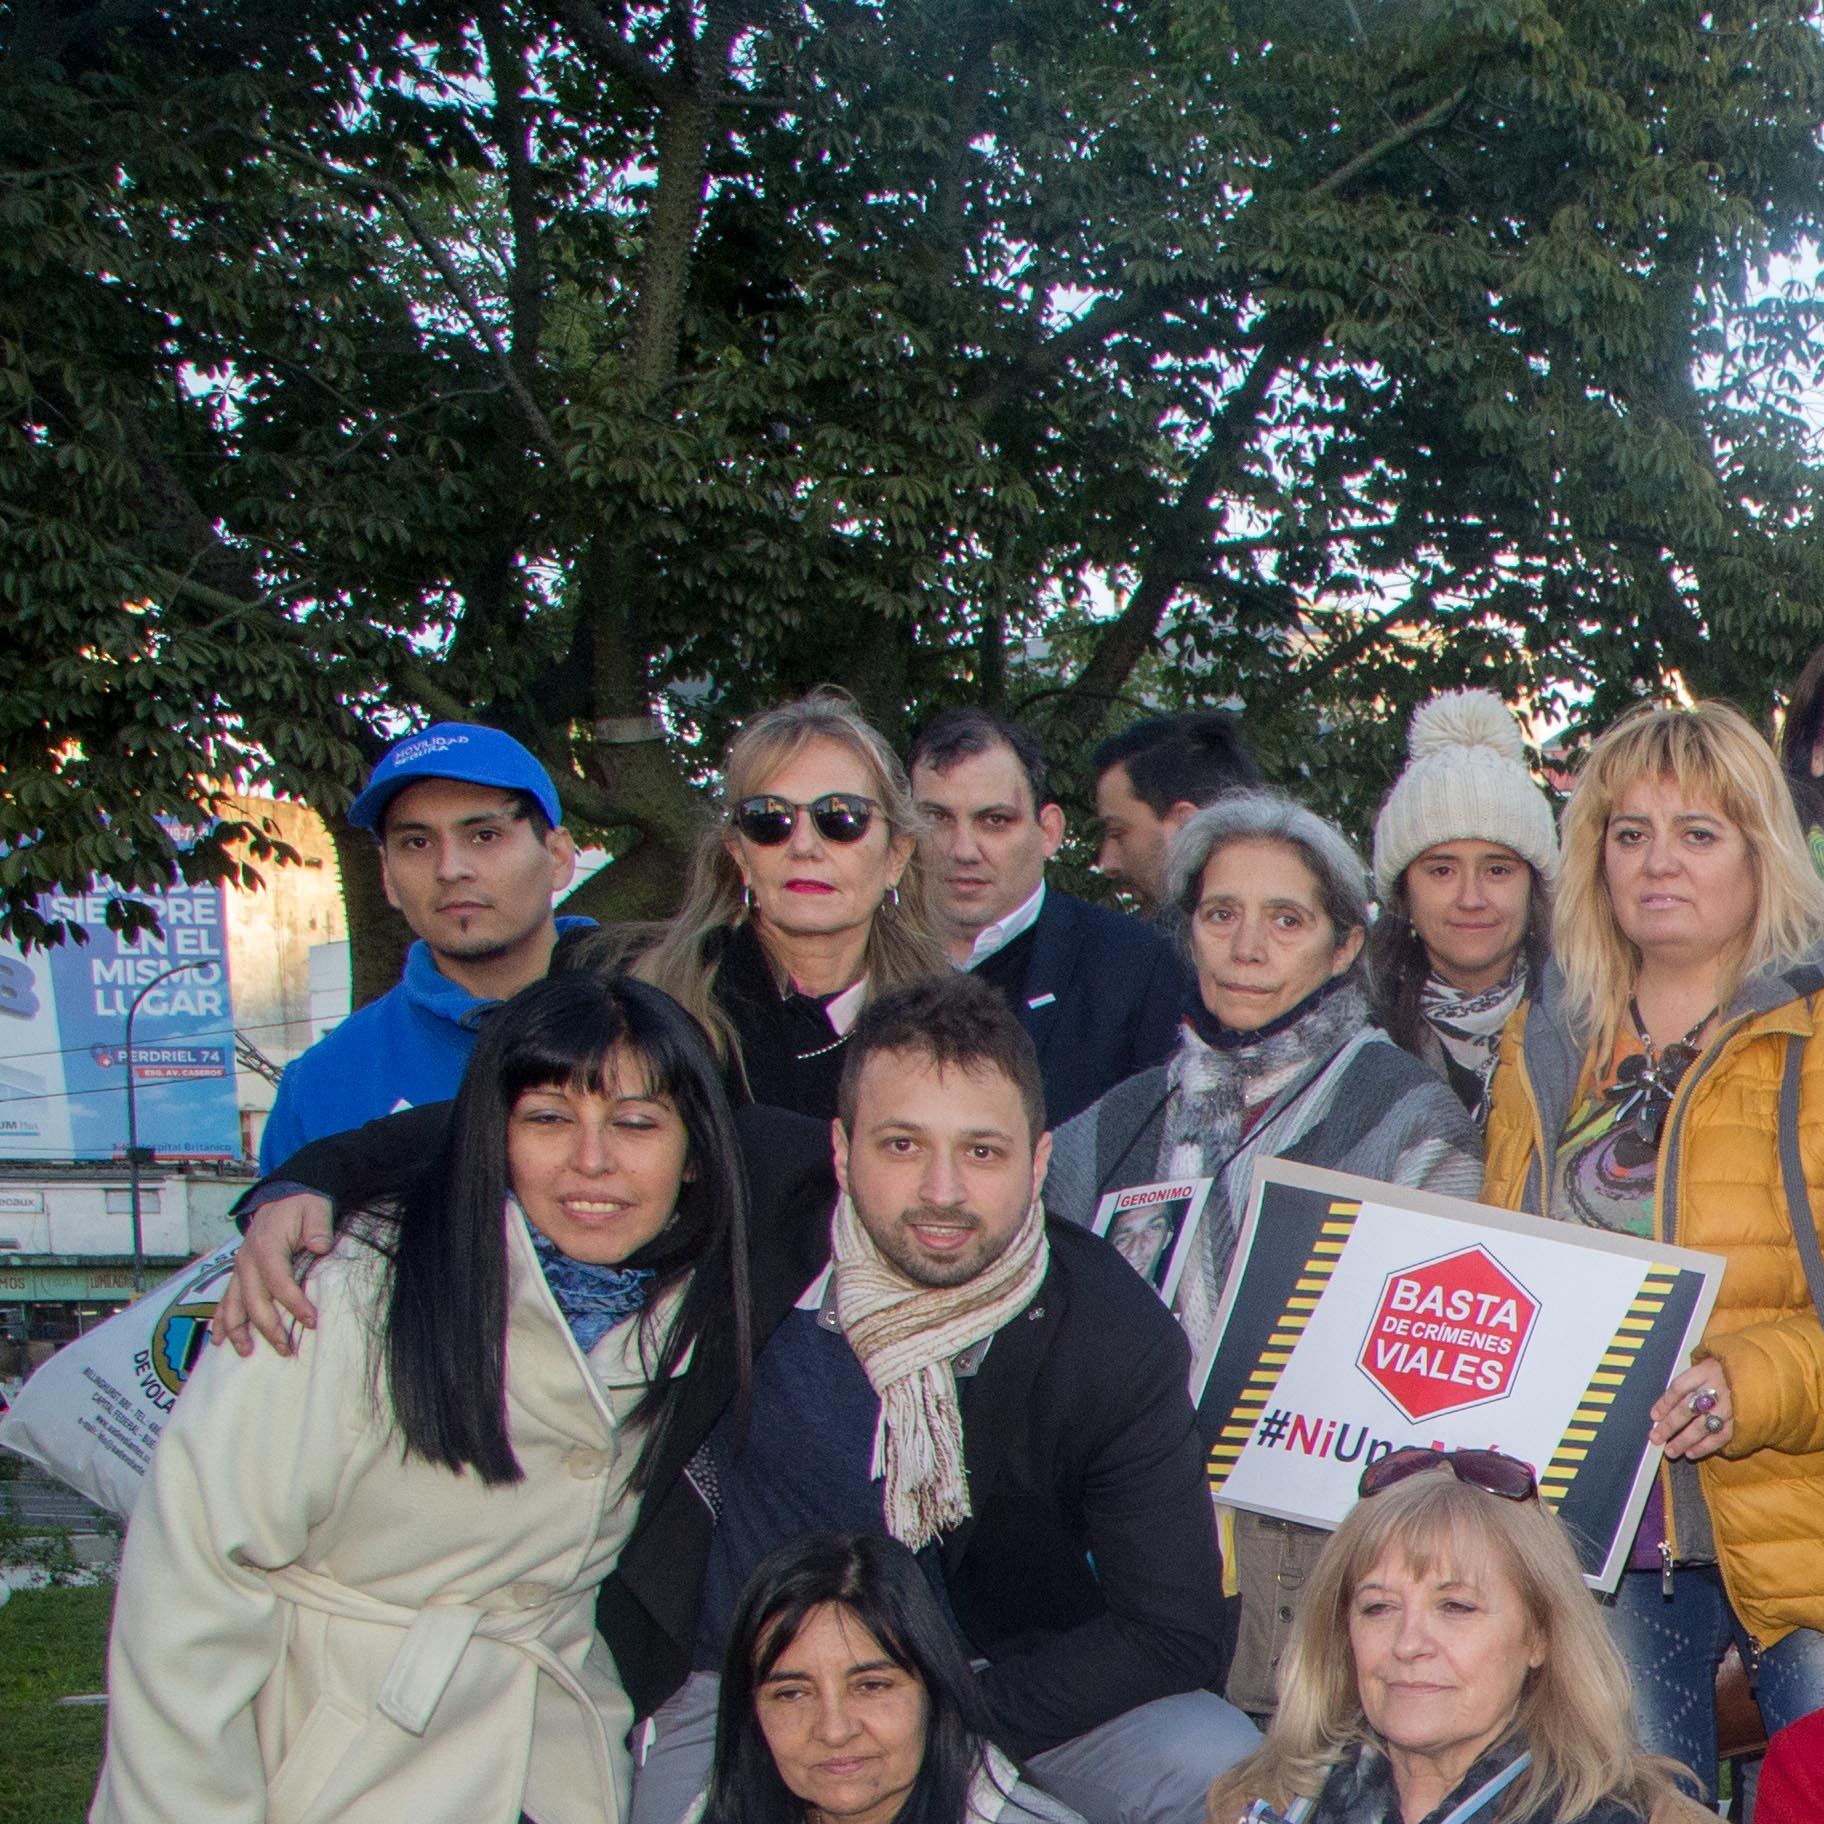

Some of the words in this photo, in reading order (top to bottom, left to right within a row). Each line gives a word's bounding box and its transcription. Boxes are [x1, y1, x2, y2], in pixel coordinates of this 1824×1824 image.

[175, 928, 221, 955] EL
[91, 958, 222, 986] MISMO
[95, 990, 223, 1016] LUGAR
[118, 1050, 197, 1063] PERDRIEL
[201, 1050, 220, 1063] 74
[1121, 1185, 1193, 1208] GERONIMO
[1391, 1279, 1518, 1332] BASTA
[1382, 1316, 1410, 1337] DE
[1411, 1322, 1512, 1355] CRÍMENES
[1376, 1339, 1504, 1391] VIALES
